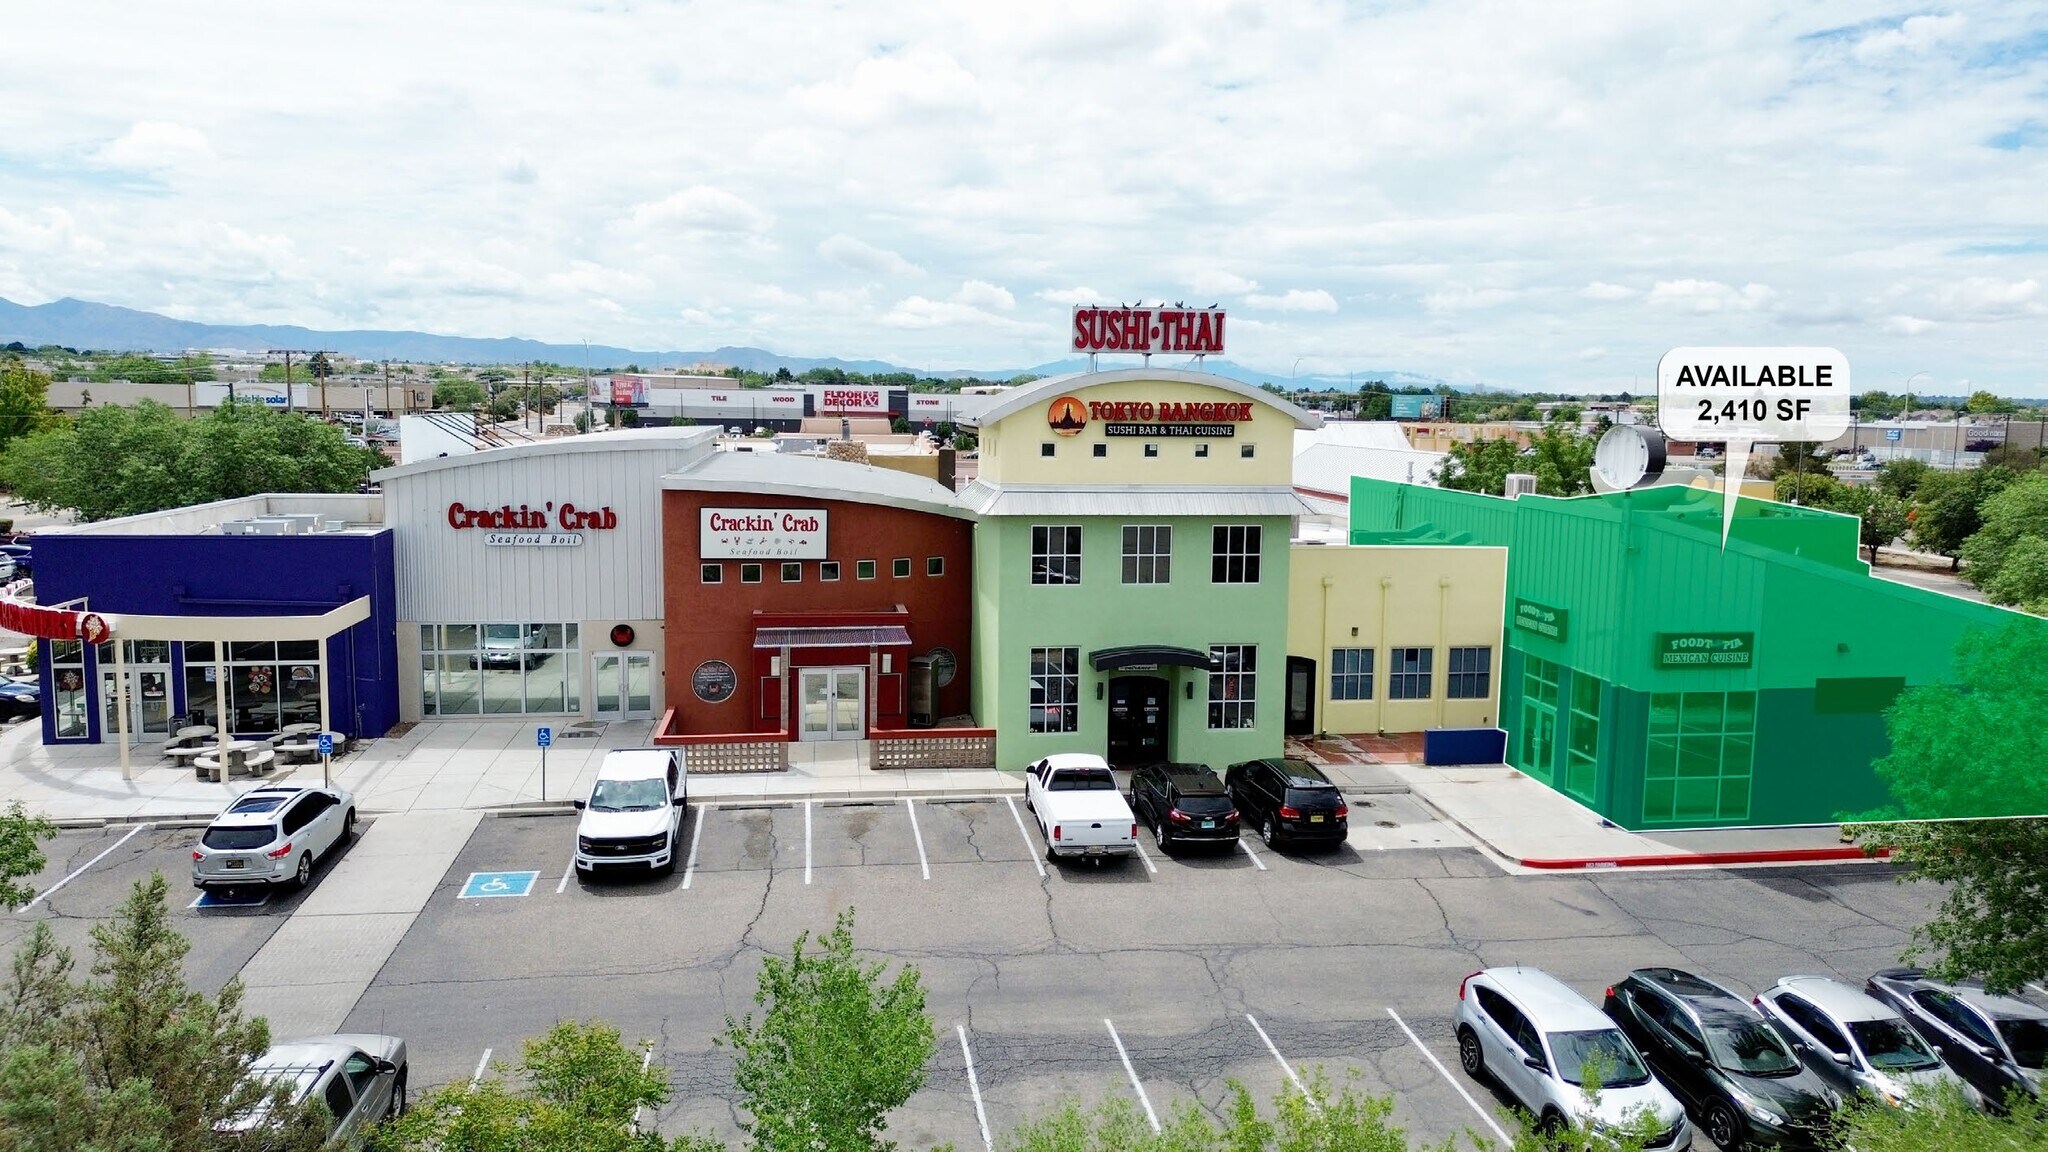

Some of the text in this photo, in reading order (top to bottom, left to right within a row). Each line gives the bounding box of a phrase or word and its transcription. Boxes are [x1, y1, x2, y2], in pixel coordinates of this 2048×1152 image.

[265, 394, 287, 404] solar
[824, 390, 862, 399] FLOOR
[824, 398, 862, 407] DECOR
[1088, 401, 1254, 423] TOKYO BANGKOK
[1107, 425, 1233, 436] SUSHI BAR & THAI CUISINE
[448, 501, 617, 530] Crackin' Crab
[710, 512, 819, 532] Crackin' Crab
[489, 533, 578, 546] Seafood Boil
[729, 547, 798, 557] Seafood Boil
[1662, 652, 1749, 664] MEXICAN CUISINE
